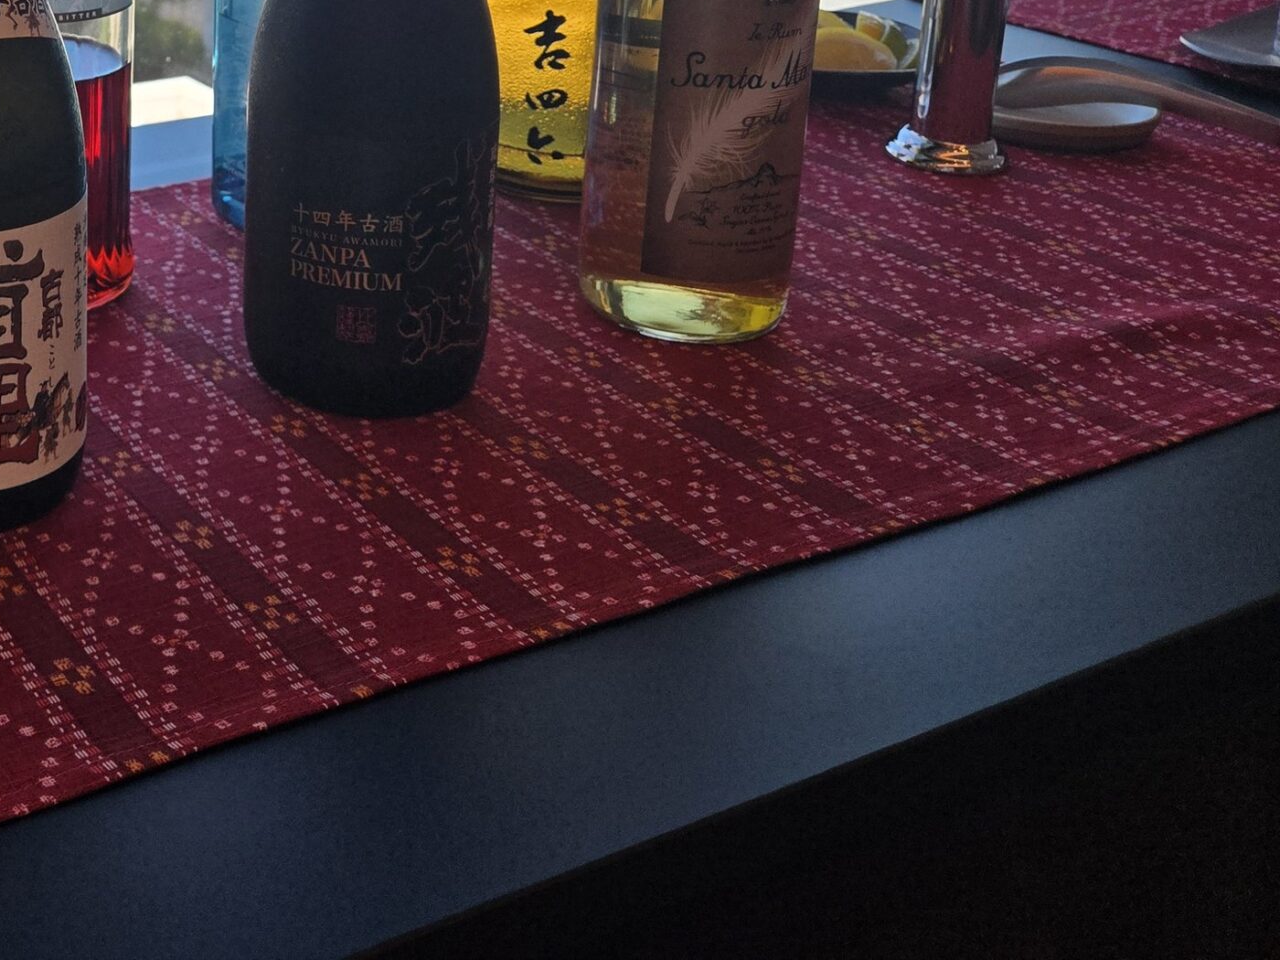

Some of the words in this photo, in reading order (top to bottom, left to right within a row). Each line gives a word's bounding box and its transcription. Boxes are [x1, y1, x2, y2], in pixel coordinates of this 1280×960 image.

[670, 51, 767, 90] Santa
[293, 201, 404, 234] 十四年古酒
[290, 236, 372, 270] ZANPA
[290, 258, 403, 292] PREMIUM
